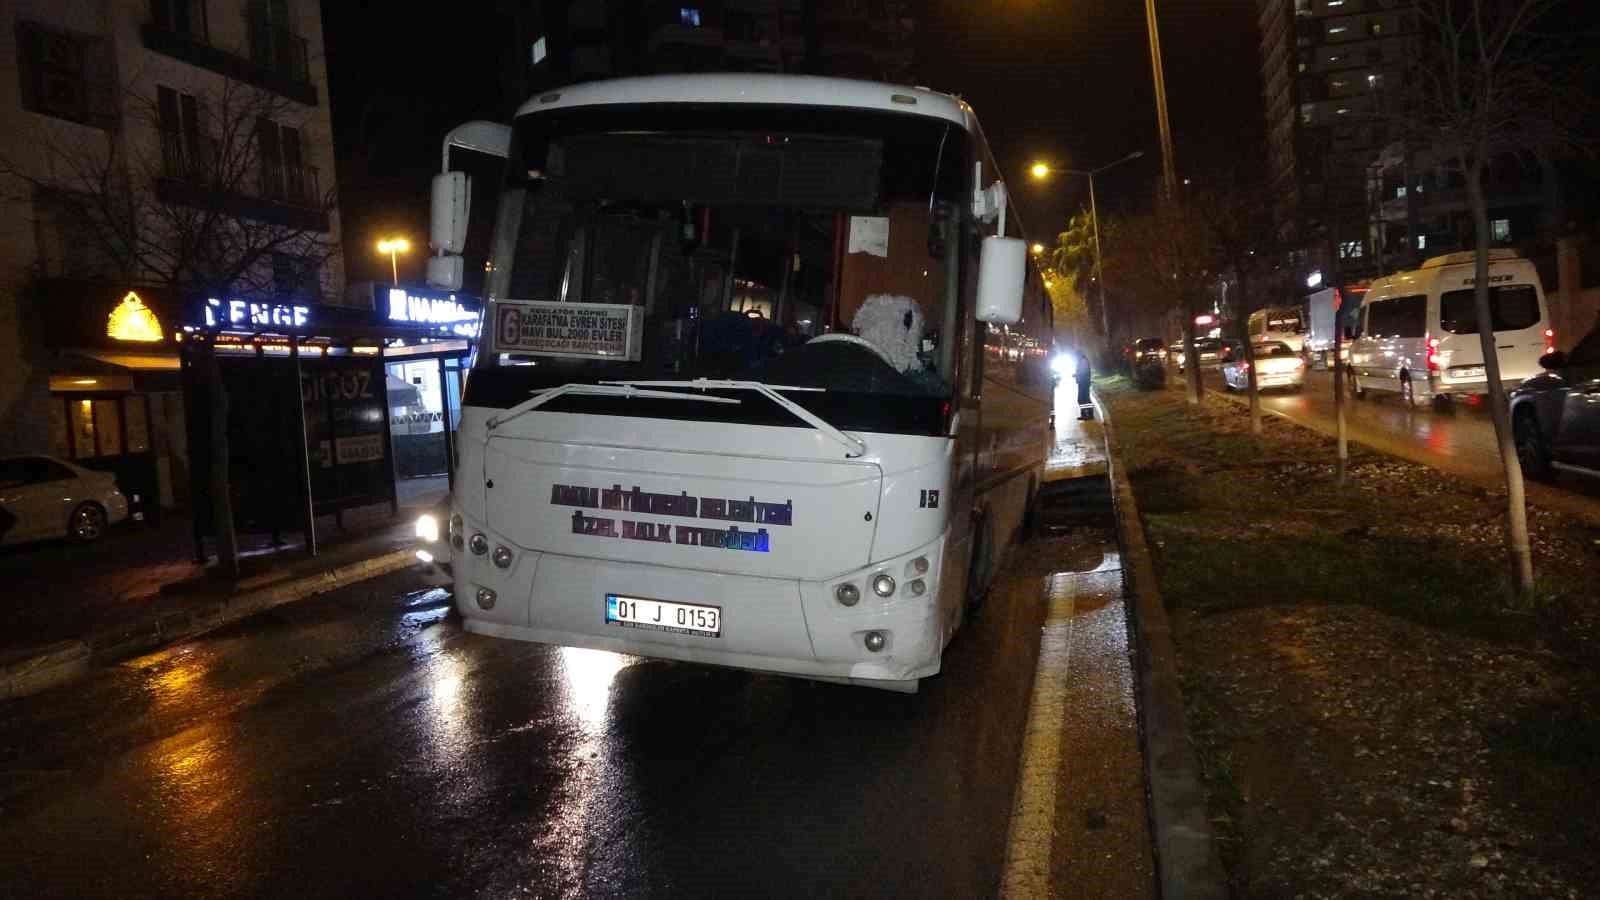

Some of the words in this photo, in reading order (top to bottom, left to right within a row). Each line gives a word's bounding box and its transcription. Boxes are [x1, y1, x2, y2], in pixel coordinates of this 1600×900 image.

[502, 310, 520, 344] 6
[570, 317, 598, 329] EVREN
[618, 600, 637, 620] 01
[652, 605, 662, 622] J
[677, 607, 717, 629] 0153
